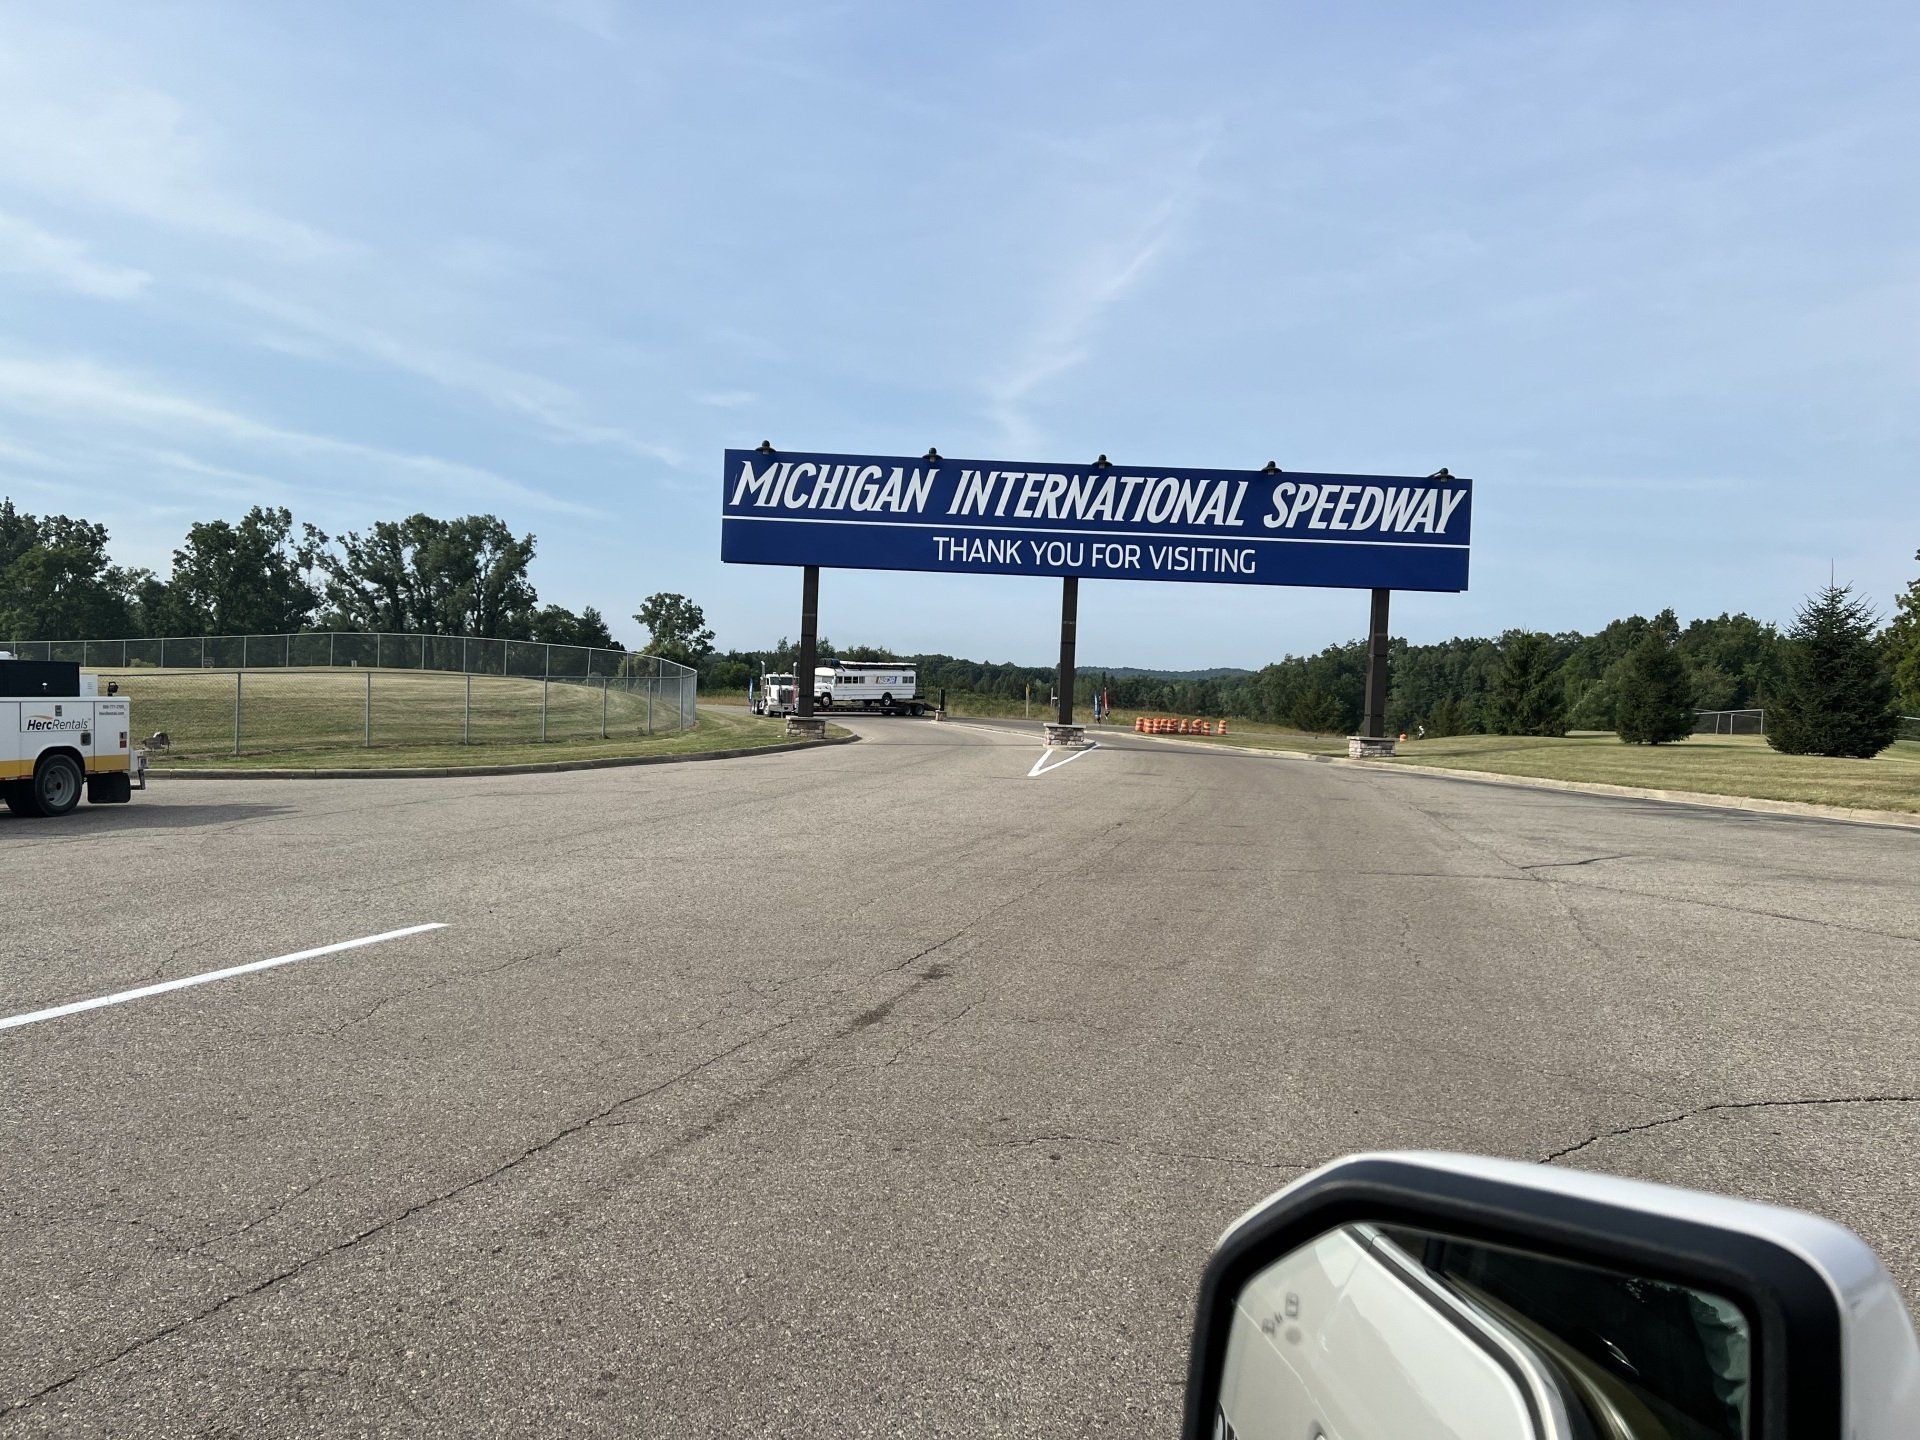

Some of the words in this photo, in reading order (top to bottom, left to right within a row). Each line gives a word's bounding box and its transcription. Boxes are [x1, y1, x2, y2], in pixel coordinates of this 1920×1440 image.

[728, 460, 940, 514] MICHIGAN
[945, 469, 1249, 526] INTERNATIONAL
[1263, 481, 1467, 534] SPEEDWAY
[932, 536, 1023, 565] THANK
[1030, 540, 1084, 567] YOU
[1091, 543, 1141, 569] FOR
[1148, 545, 1256, 574] VISITING
